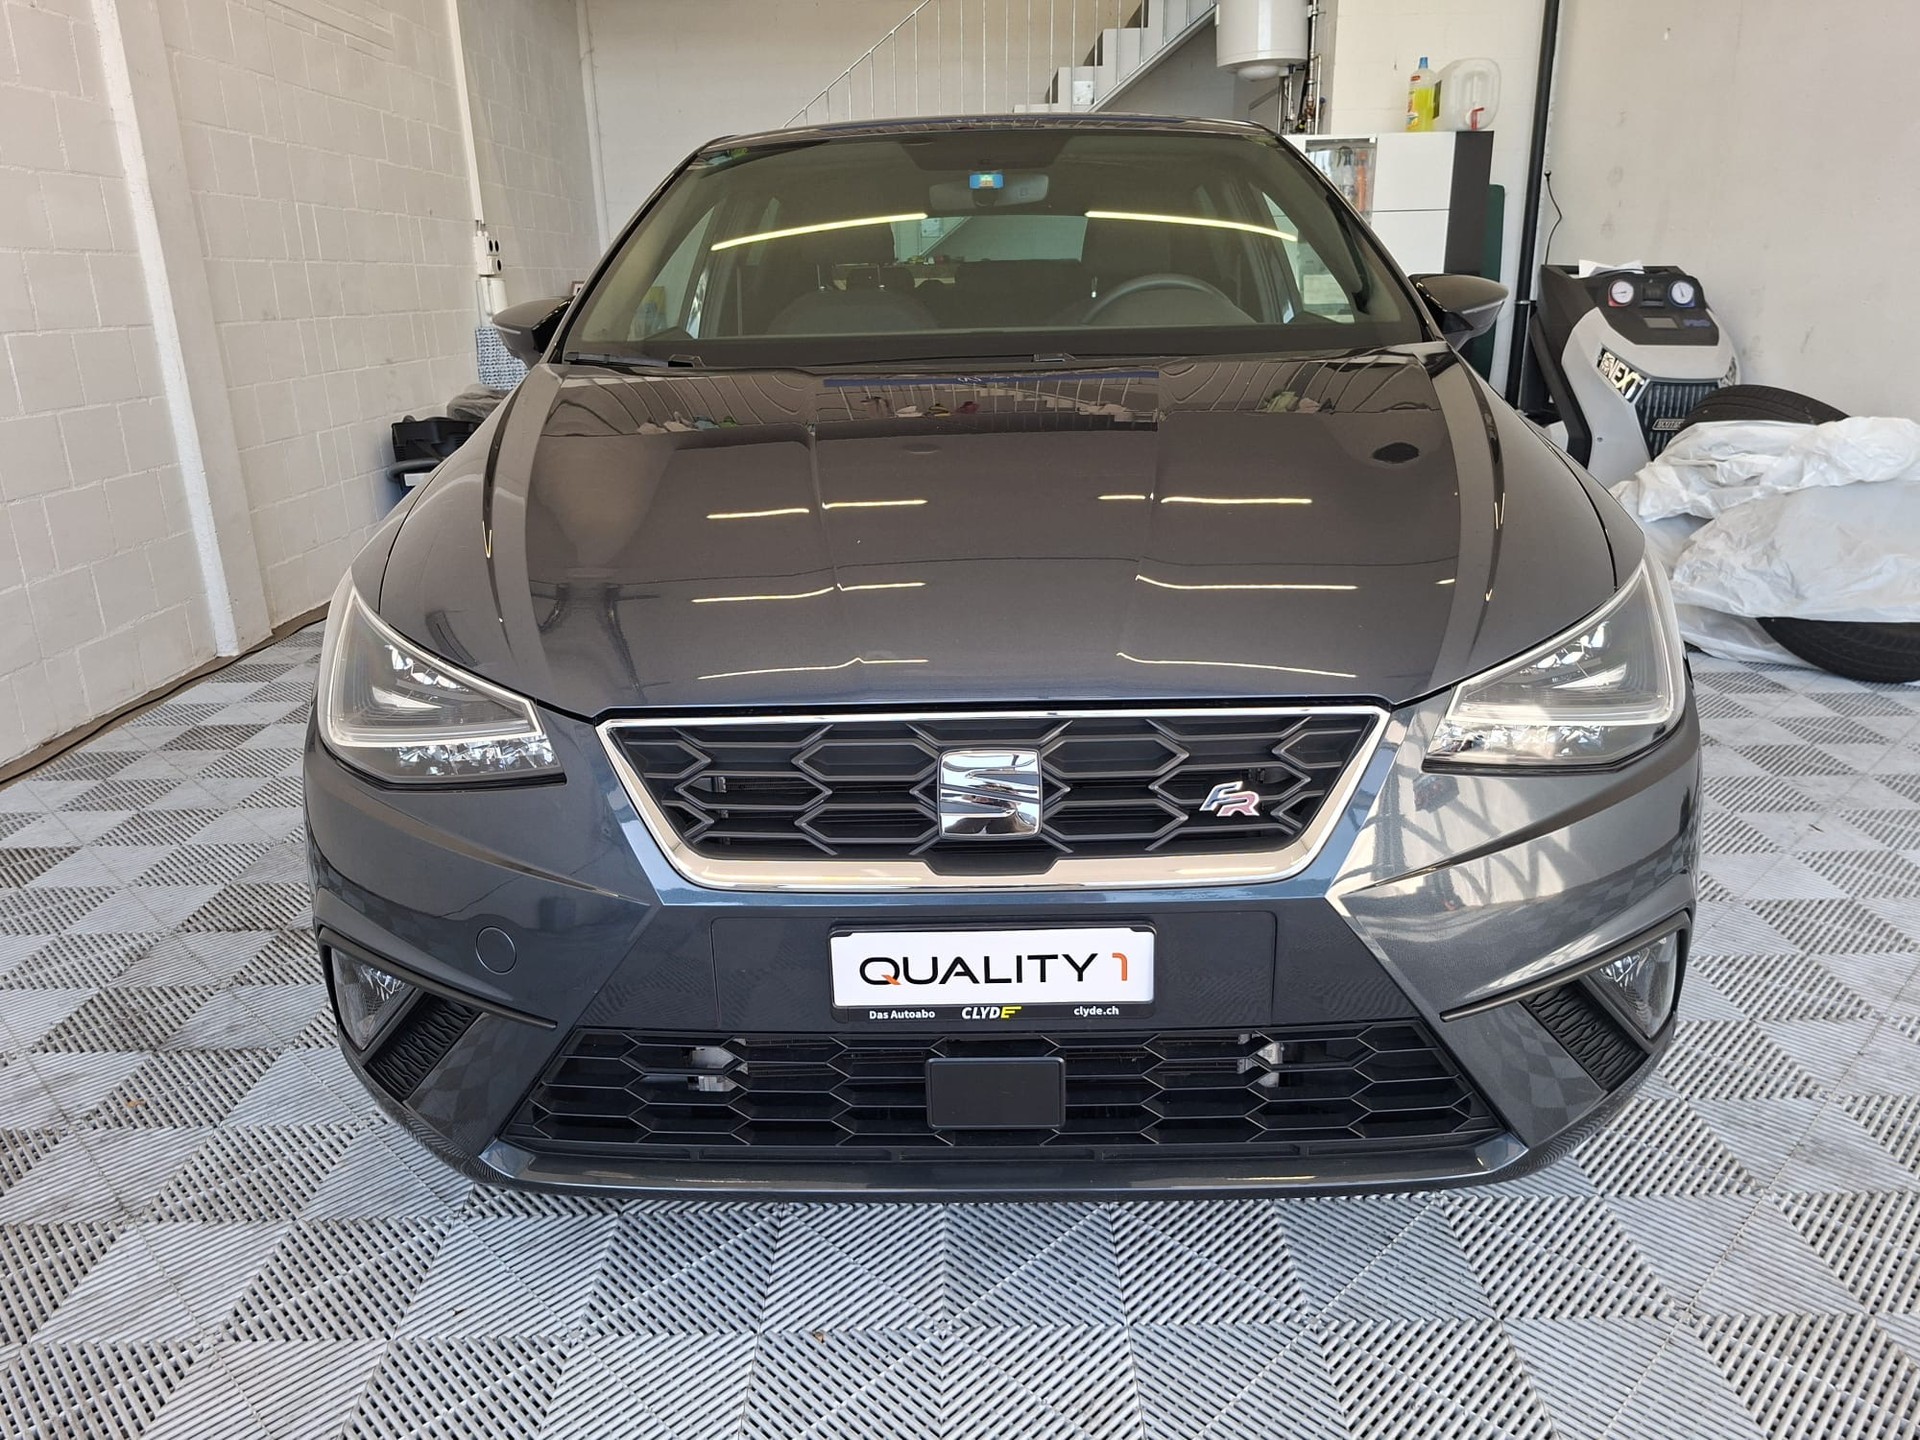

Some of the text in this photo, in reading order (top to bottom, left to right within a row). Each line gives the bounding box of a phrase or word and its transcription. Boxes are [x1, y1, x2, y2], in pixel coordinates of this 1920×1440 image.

[1199, 780, 1260, 817] FR
[860, 953, 1127, 985] QUALITY 1
[869, 1008, 936, 1020] Das Autoabo
[962, 1006, 1021, 1019] CLYDE
[1073, 1005, 1120, 1017] clyde.ch
